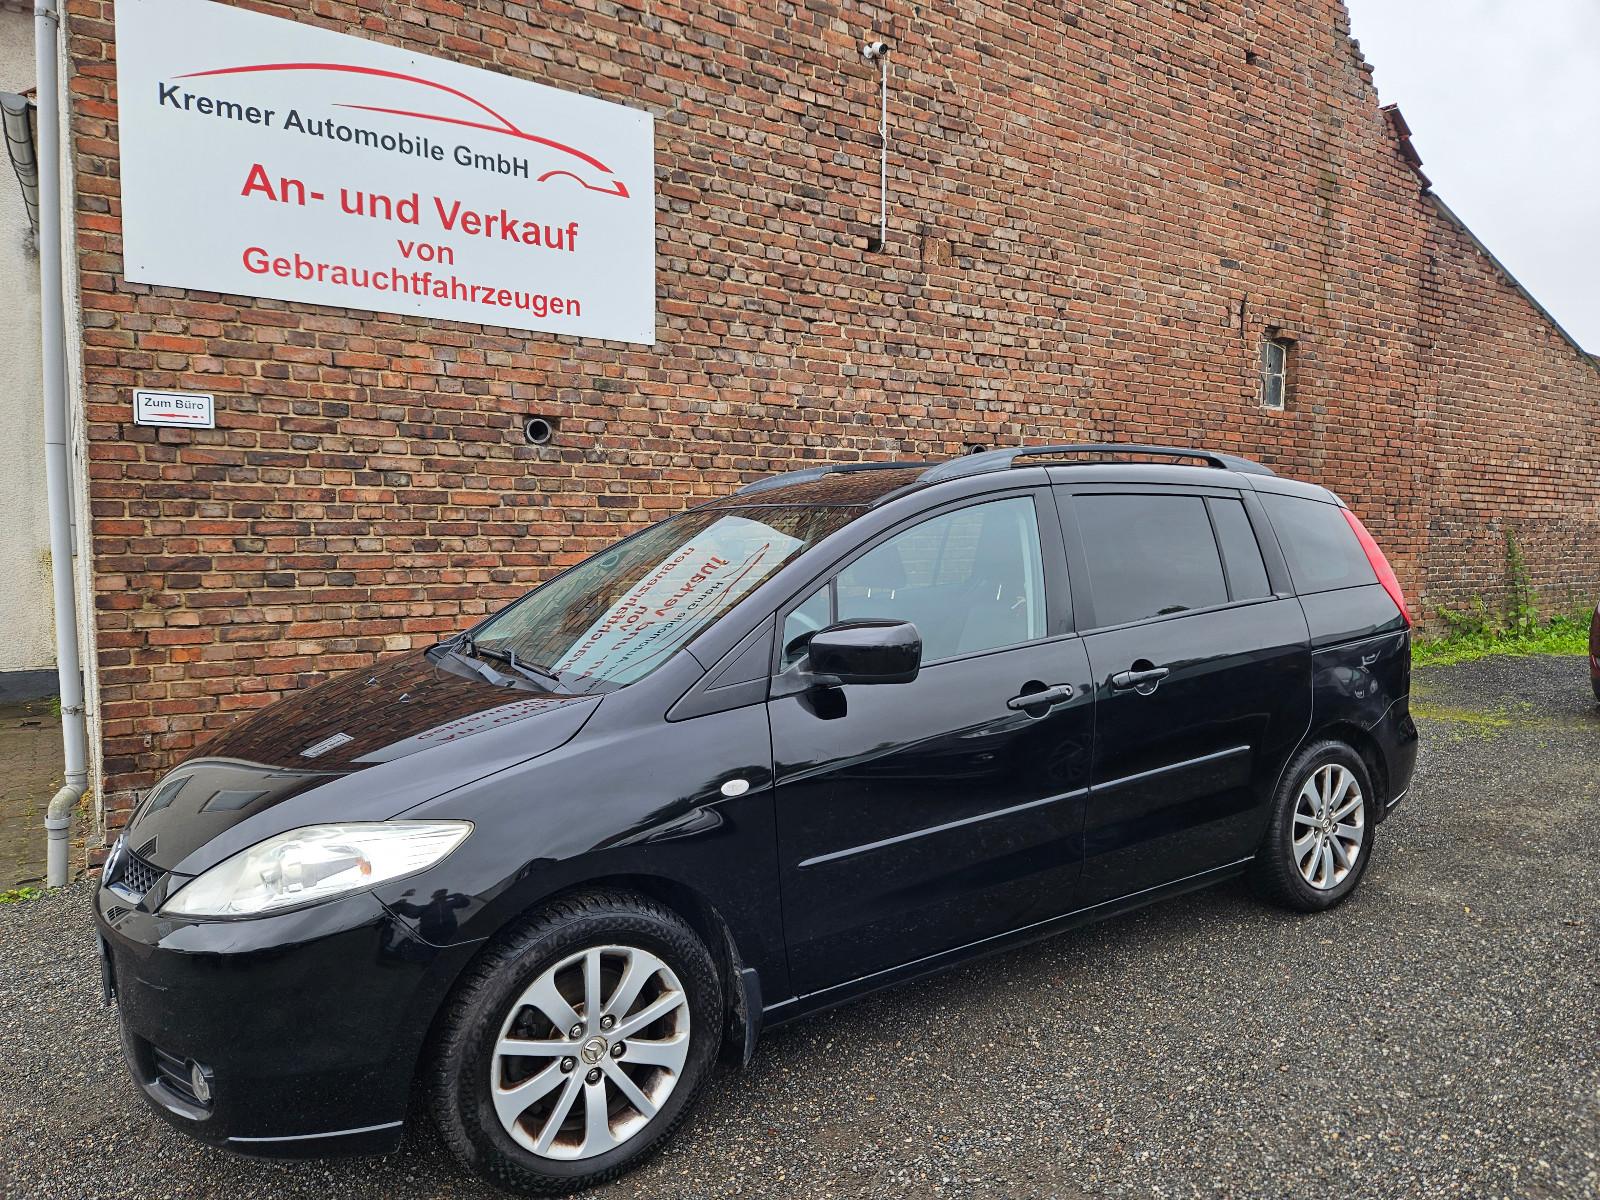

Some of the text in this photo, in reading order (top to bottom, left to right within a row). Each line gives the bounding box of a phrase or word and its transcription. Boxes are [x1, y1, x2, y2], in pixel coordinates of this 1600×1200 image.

[159, 82, 529, 179] Kremer Automobile GmbH
[241, 162, 578, 253] An- und Verkauf
[242, 246, 581, 319] Gebrauchtfahrzeugen
[397, 239, 454, 265] von
[144, 397, 204, 410] Zum Büro
